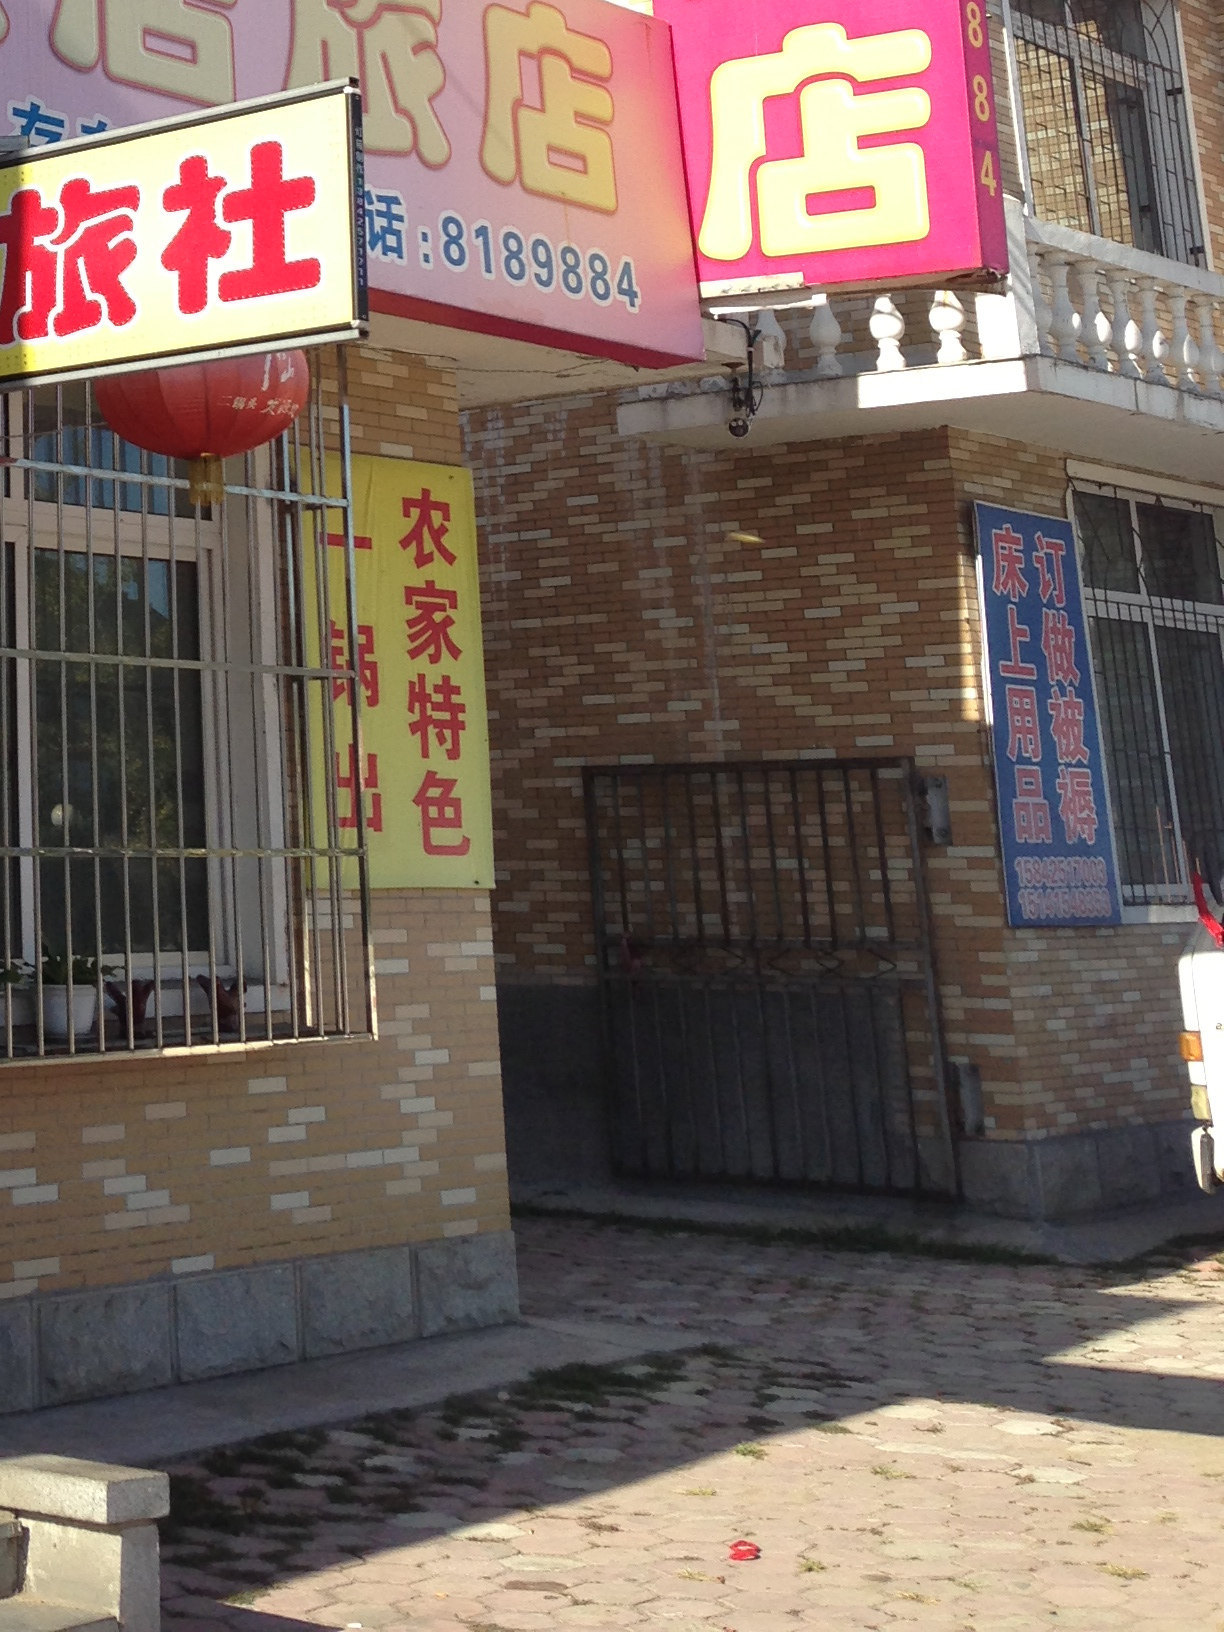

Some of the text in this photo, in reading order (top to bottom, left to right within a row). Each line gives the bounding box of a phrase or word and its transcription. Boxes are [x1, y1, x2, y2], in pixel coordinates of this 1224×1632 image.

[319, 531, 384, 833] 一锅出
[398, 487, 472, 857] 农家特色
[991, 523, 1052, 845] 床上用品
[1033, 531, 1099, 846] 订做被褥
